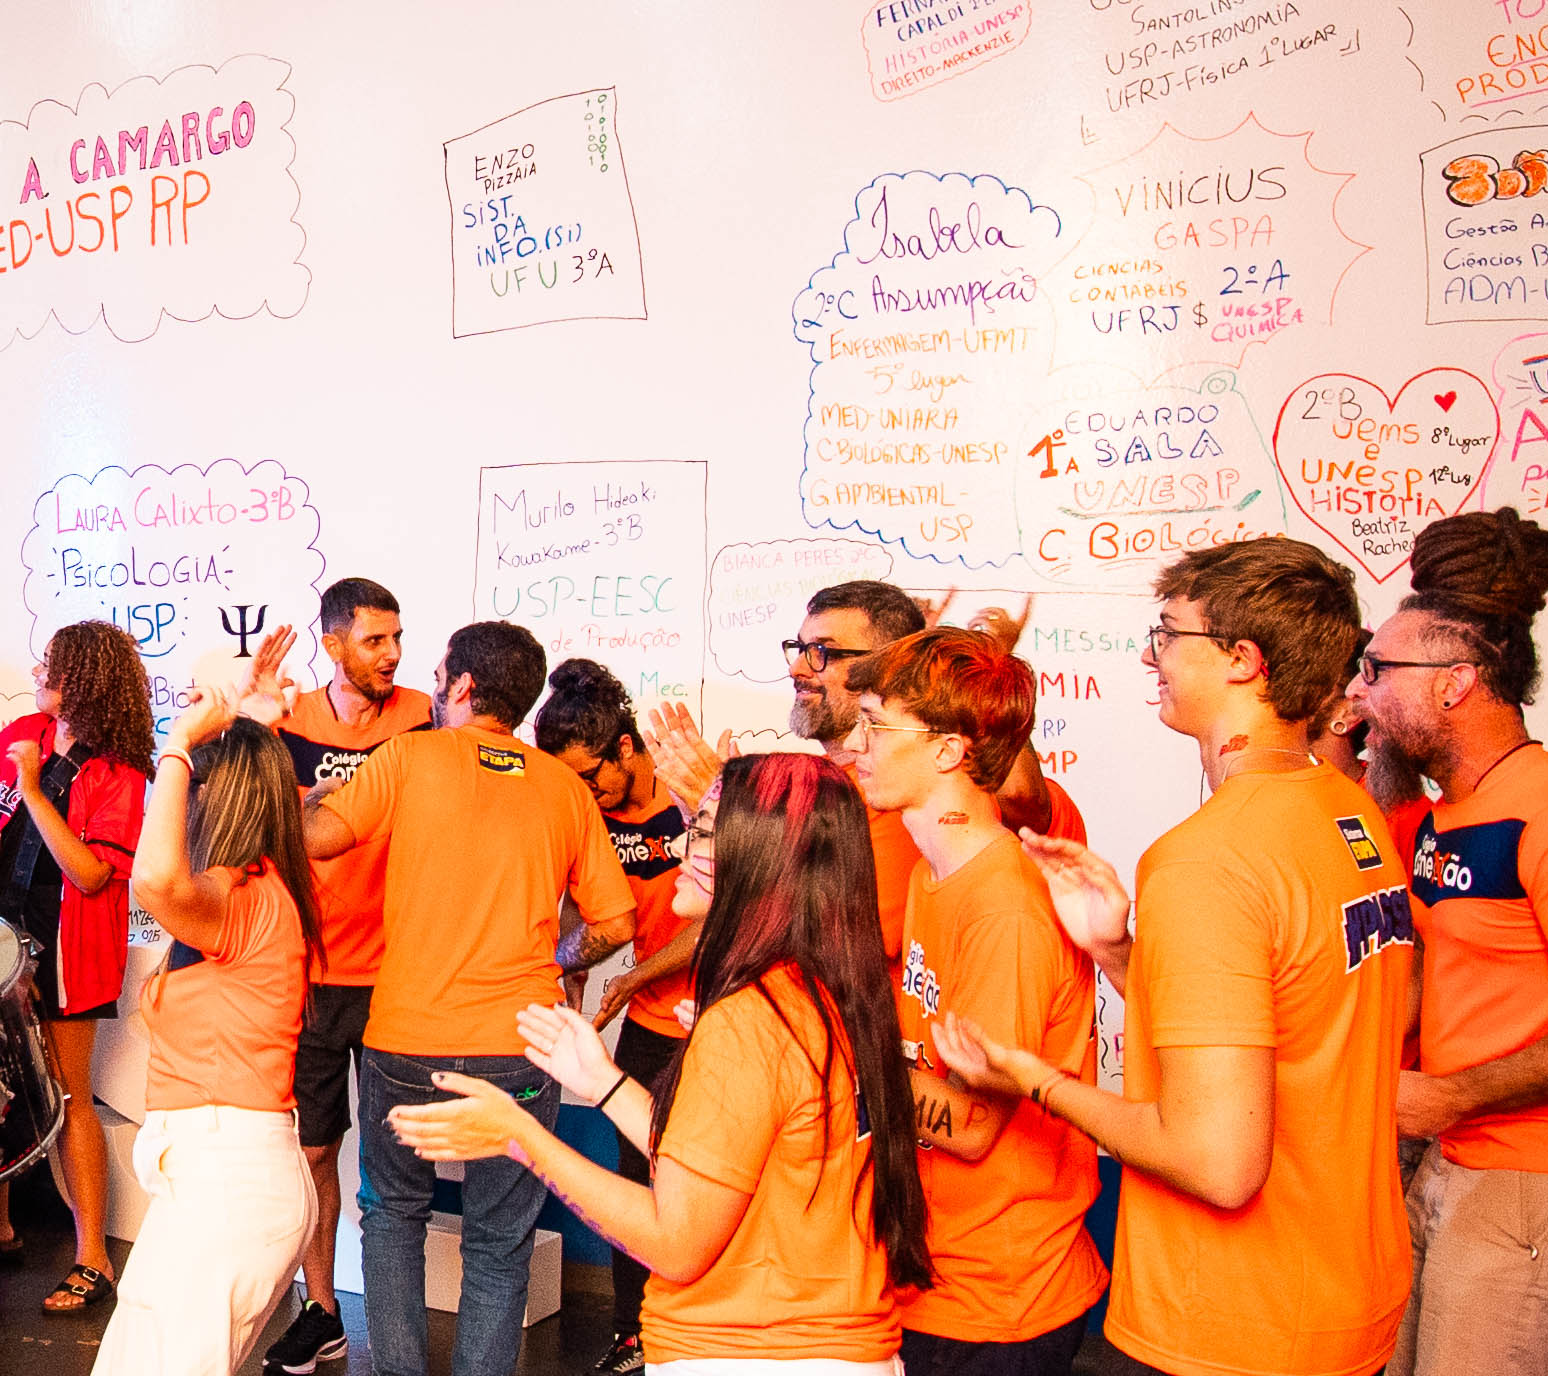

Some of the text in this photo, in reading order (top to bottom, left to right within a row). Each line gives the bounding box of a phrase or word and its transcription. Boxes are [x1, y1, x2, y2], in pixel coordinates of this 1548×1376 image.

[70, 100, 256, 184] CAMARGO
[474, 143, 535, 180] ENZO
[151, 170, 211, 246] RP
[857, 185, 1026, 266] Isabela
[495, 218, 527, 242] DA
[490, 262, 558, 299] UFU
[1092, 304, 1179, 335] UFRJ
[1065, 404, 1219, 434] EDUARDO
[1096, 431, 1223, 468] SALA
[1074, 470, 1240, 511] UNESP
[493, 489, 575, 534] Murilo
[920, 515, 973, 543] USP
[1351, 517, 1411, 538] Beatriz
[550, 624, 680, 654] de Produção
